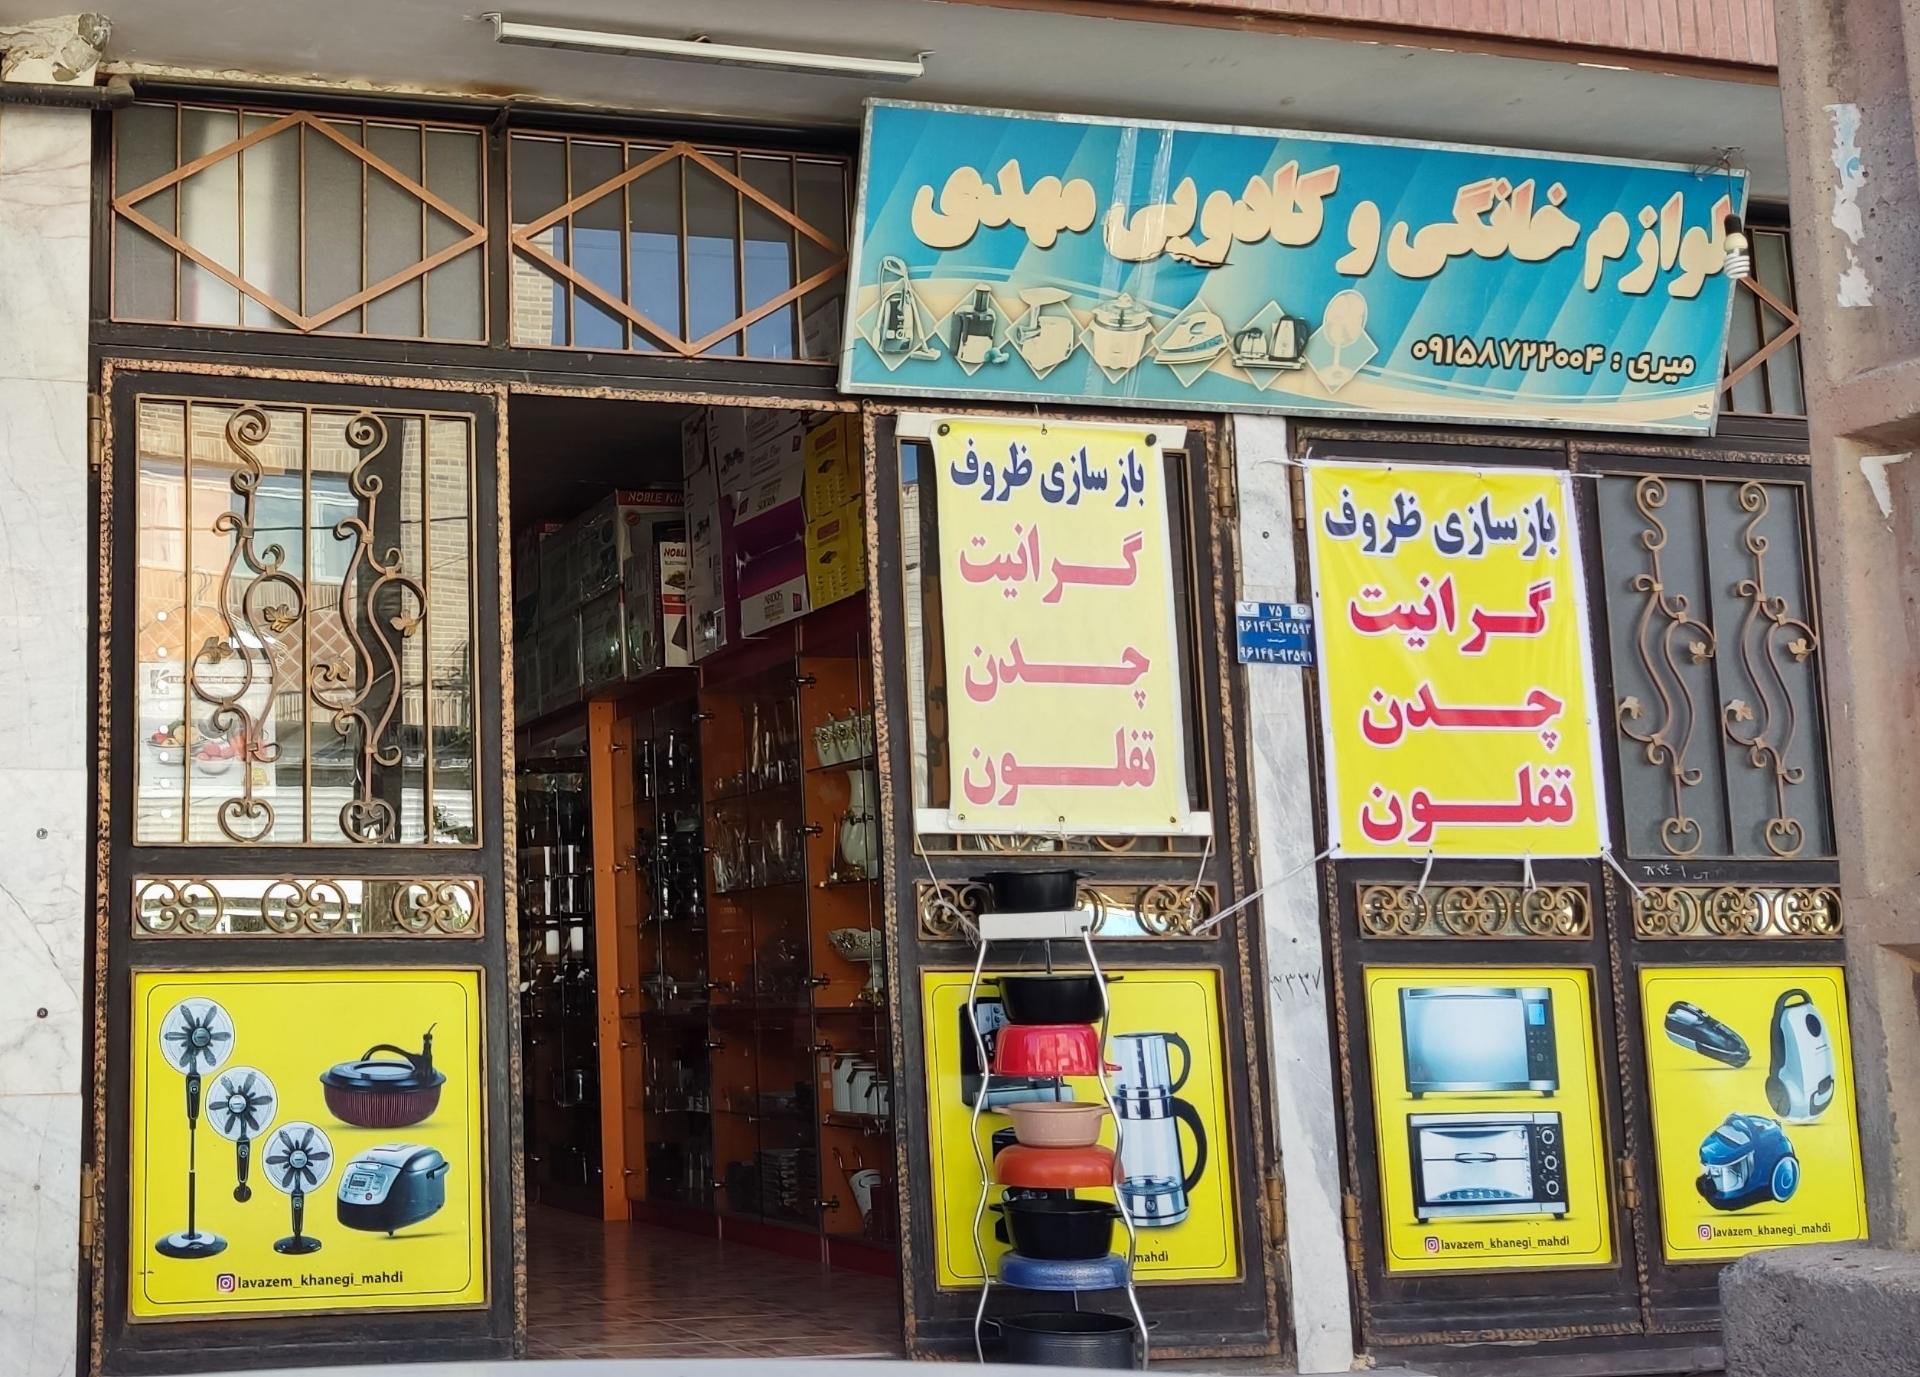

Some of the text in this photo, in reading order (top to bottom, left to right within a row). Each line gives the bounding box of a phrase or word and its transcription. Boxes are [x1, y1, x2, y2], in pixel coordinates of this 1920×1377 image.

[911, 158, 1097, 249] مهدی
[1335, 200, 1381, 276] و
[1387, 176, 1581, 278] خانگی
[1584, 190, 1729, 299] لوازم
[1411, 334, 1606, 374] ۰۹۱۵۸۷۲۲۰۰۴
[1627, 352, 1696, 384] میری
[950, 437, 1145, 507] باز سازی ظروف
[663, 547, 687, 558] NOBL
[1324, 488, 1422, 554] ظروف
[958, 523, 1145, 605] گرانیت
[1268, 604, 1284, 617] ۷۵
[1350, 576, 1553, 653] گرانیت
[965, 637, 1151, 710] چدن
[1361, 683, 1563, 750] چدن
[963, 727, 1156, 806] تفلون
[1361, 764, 1575, 843] تفلون
[1441, 1235, 1570, 1251] lavazem_khanegi_mahdi
[1713, 1222, 1831, 1238] lavazem_khanegi_mahdi
[238, 1270, 404, 1289] lavazem_khanegi_mahdi
